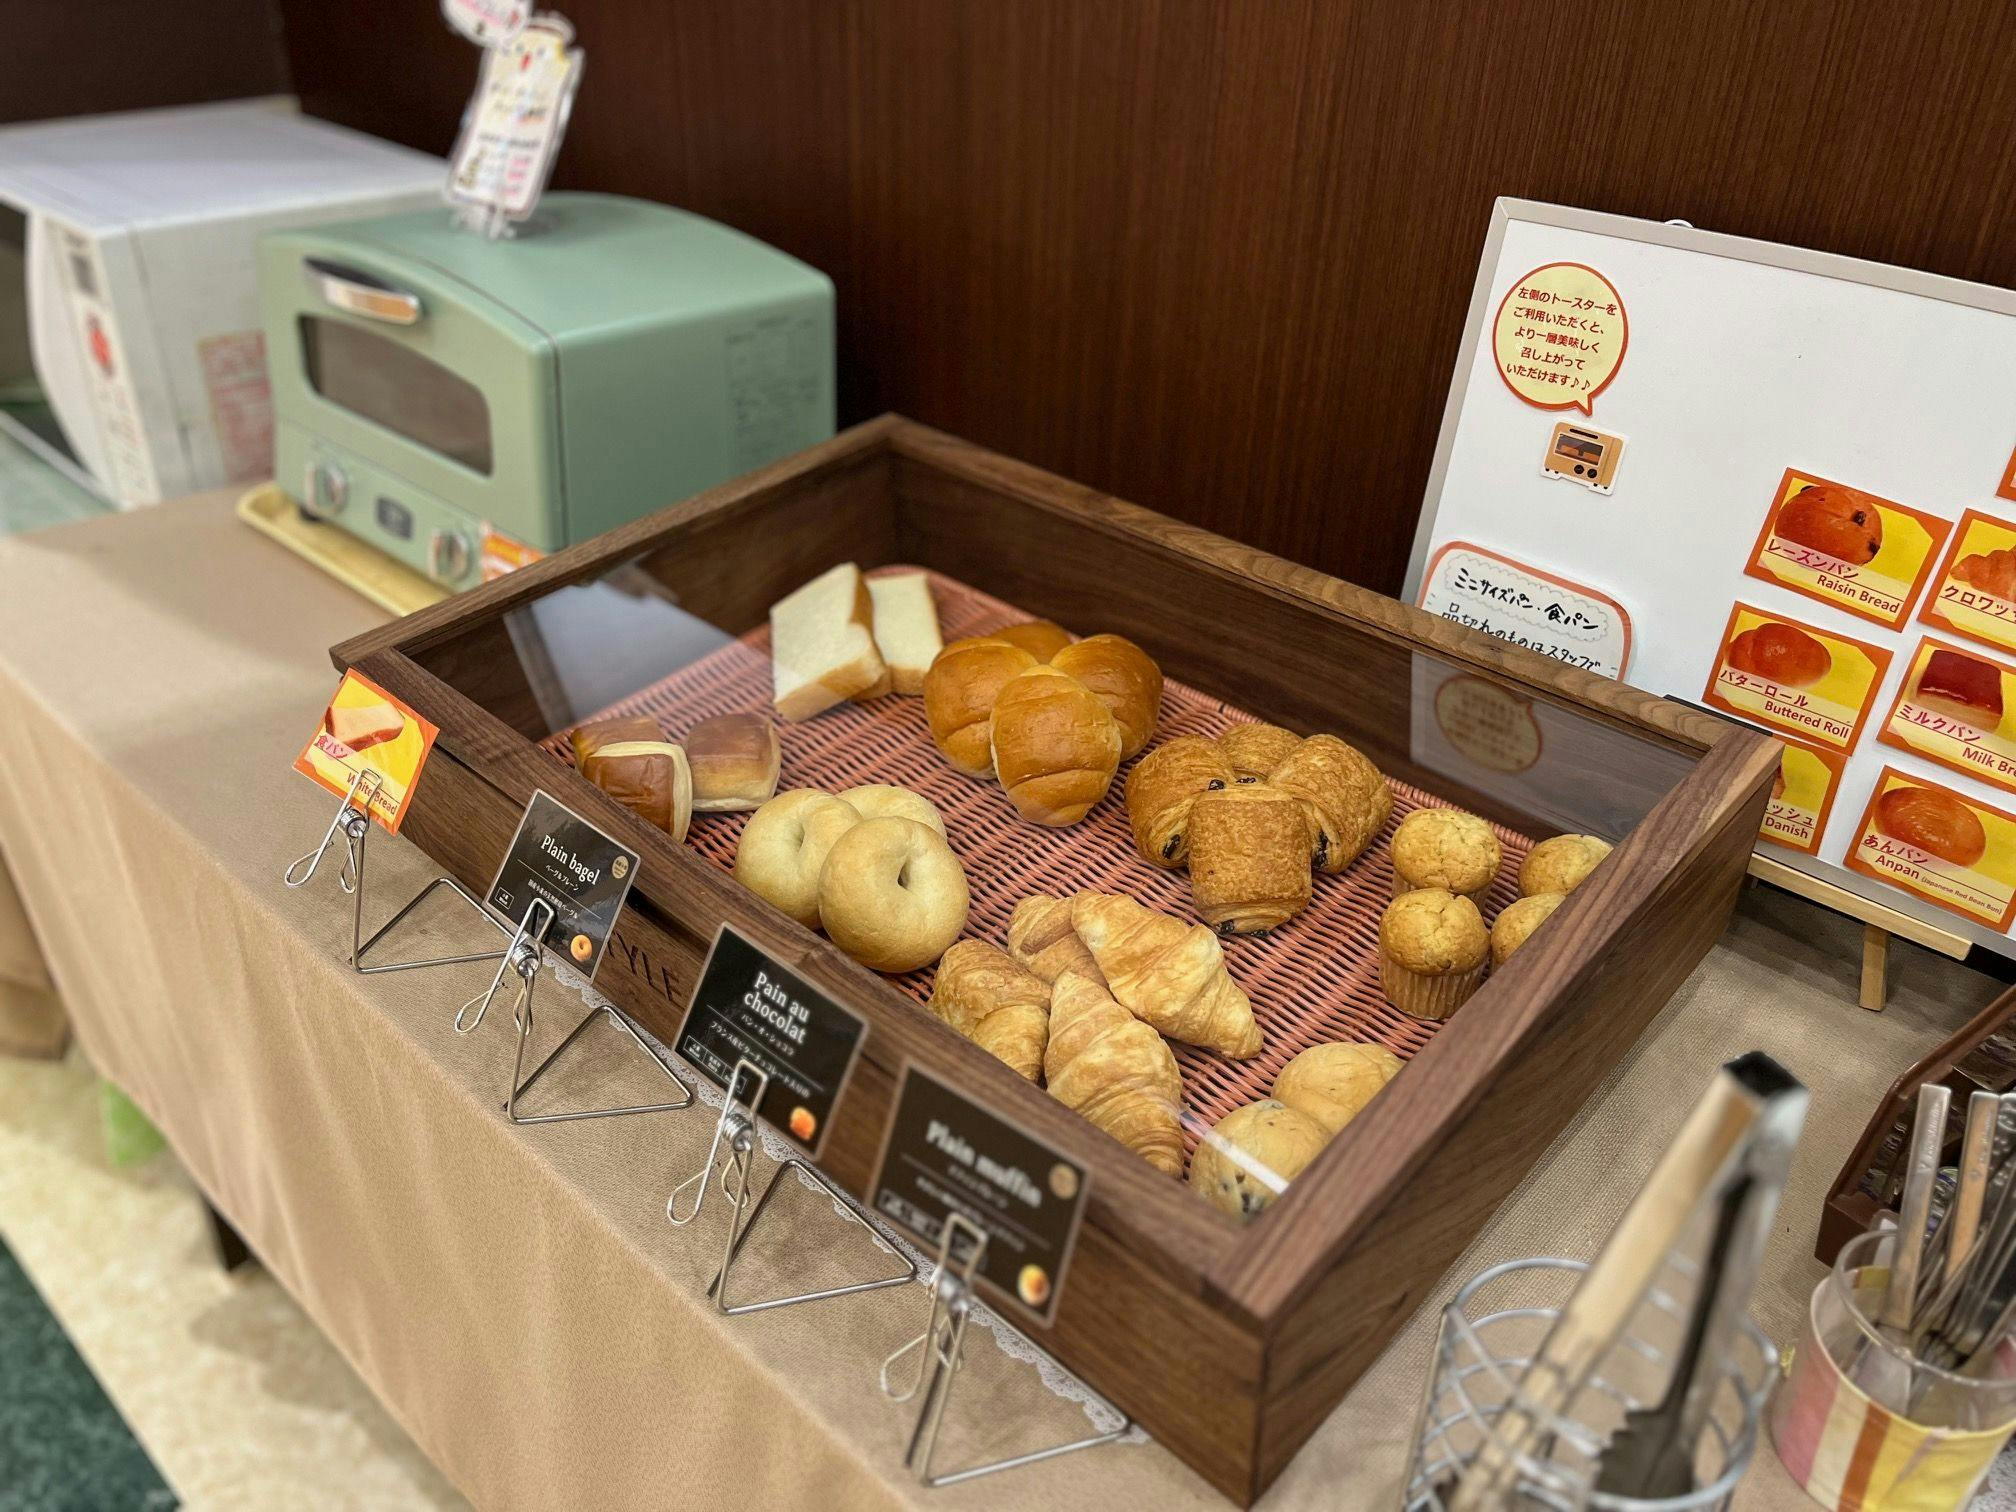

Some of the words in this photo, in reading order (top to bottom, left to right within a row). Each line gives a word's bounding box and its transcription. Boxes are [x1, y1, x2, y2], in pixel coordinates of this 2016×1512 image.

[1518, 287, 1617, 315] 左側のトースターを
[1513, 306, 1604, 334] ご利用いただくと、
[1514, 326, 1600, 353] より一層美味しく
[1521, 347, 1586, 370] 召し上がって
[1769, 539, 1859, 579] レーズンパン
[1817, 575, 1856, 598] Raisin
[1860, 591, 1900, 614] Bread
[1945, 586, 2016, 623] クロワッ
[1721, 670, 1808, 707] バターロール
[1765, 701, 1821, 728] Buttered
[1824, 722, 1850, 739] Roll
[1900, 704, 1981, 741] ミルクパン
[314, 734, 348, 759] 食パン
[1962, 747, 1995, 767] Milk
[374, 791, 398, 815] Bread
[1766, 805, 1813, 826] ッシュ
[1765, 817, 1808, 838] Danish
[540, 834, 568, 865] Plain
[568, 853, 600, 886] bagel
[1864, 835, 1928, 863] あんパン
[1875, 855, 1919, 879] Anpan
[1955, 890, 1968, 899] Red
[754, 971, 787, 1007] Pain
[789, 1001, 810, 1023] au
[744, 992, 806, 1044] chocolat
